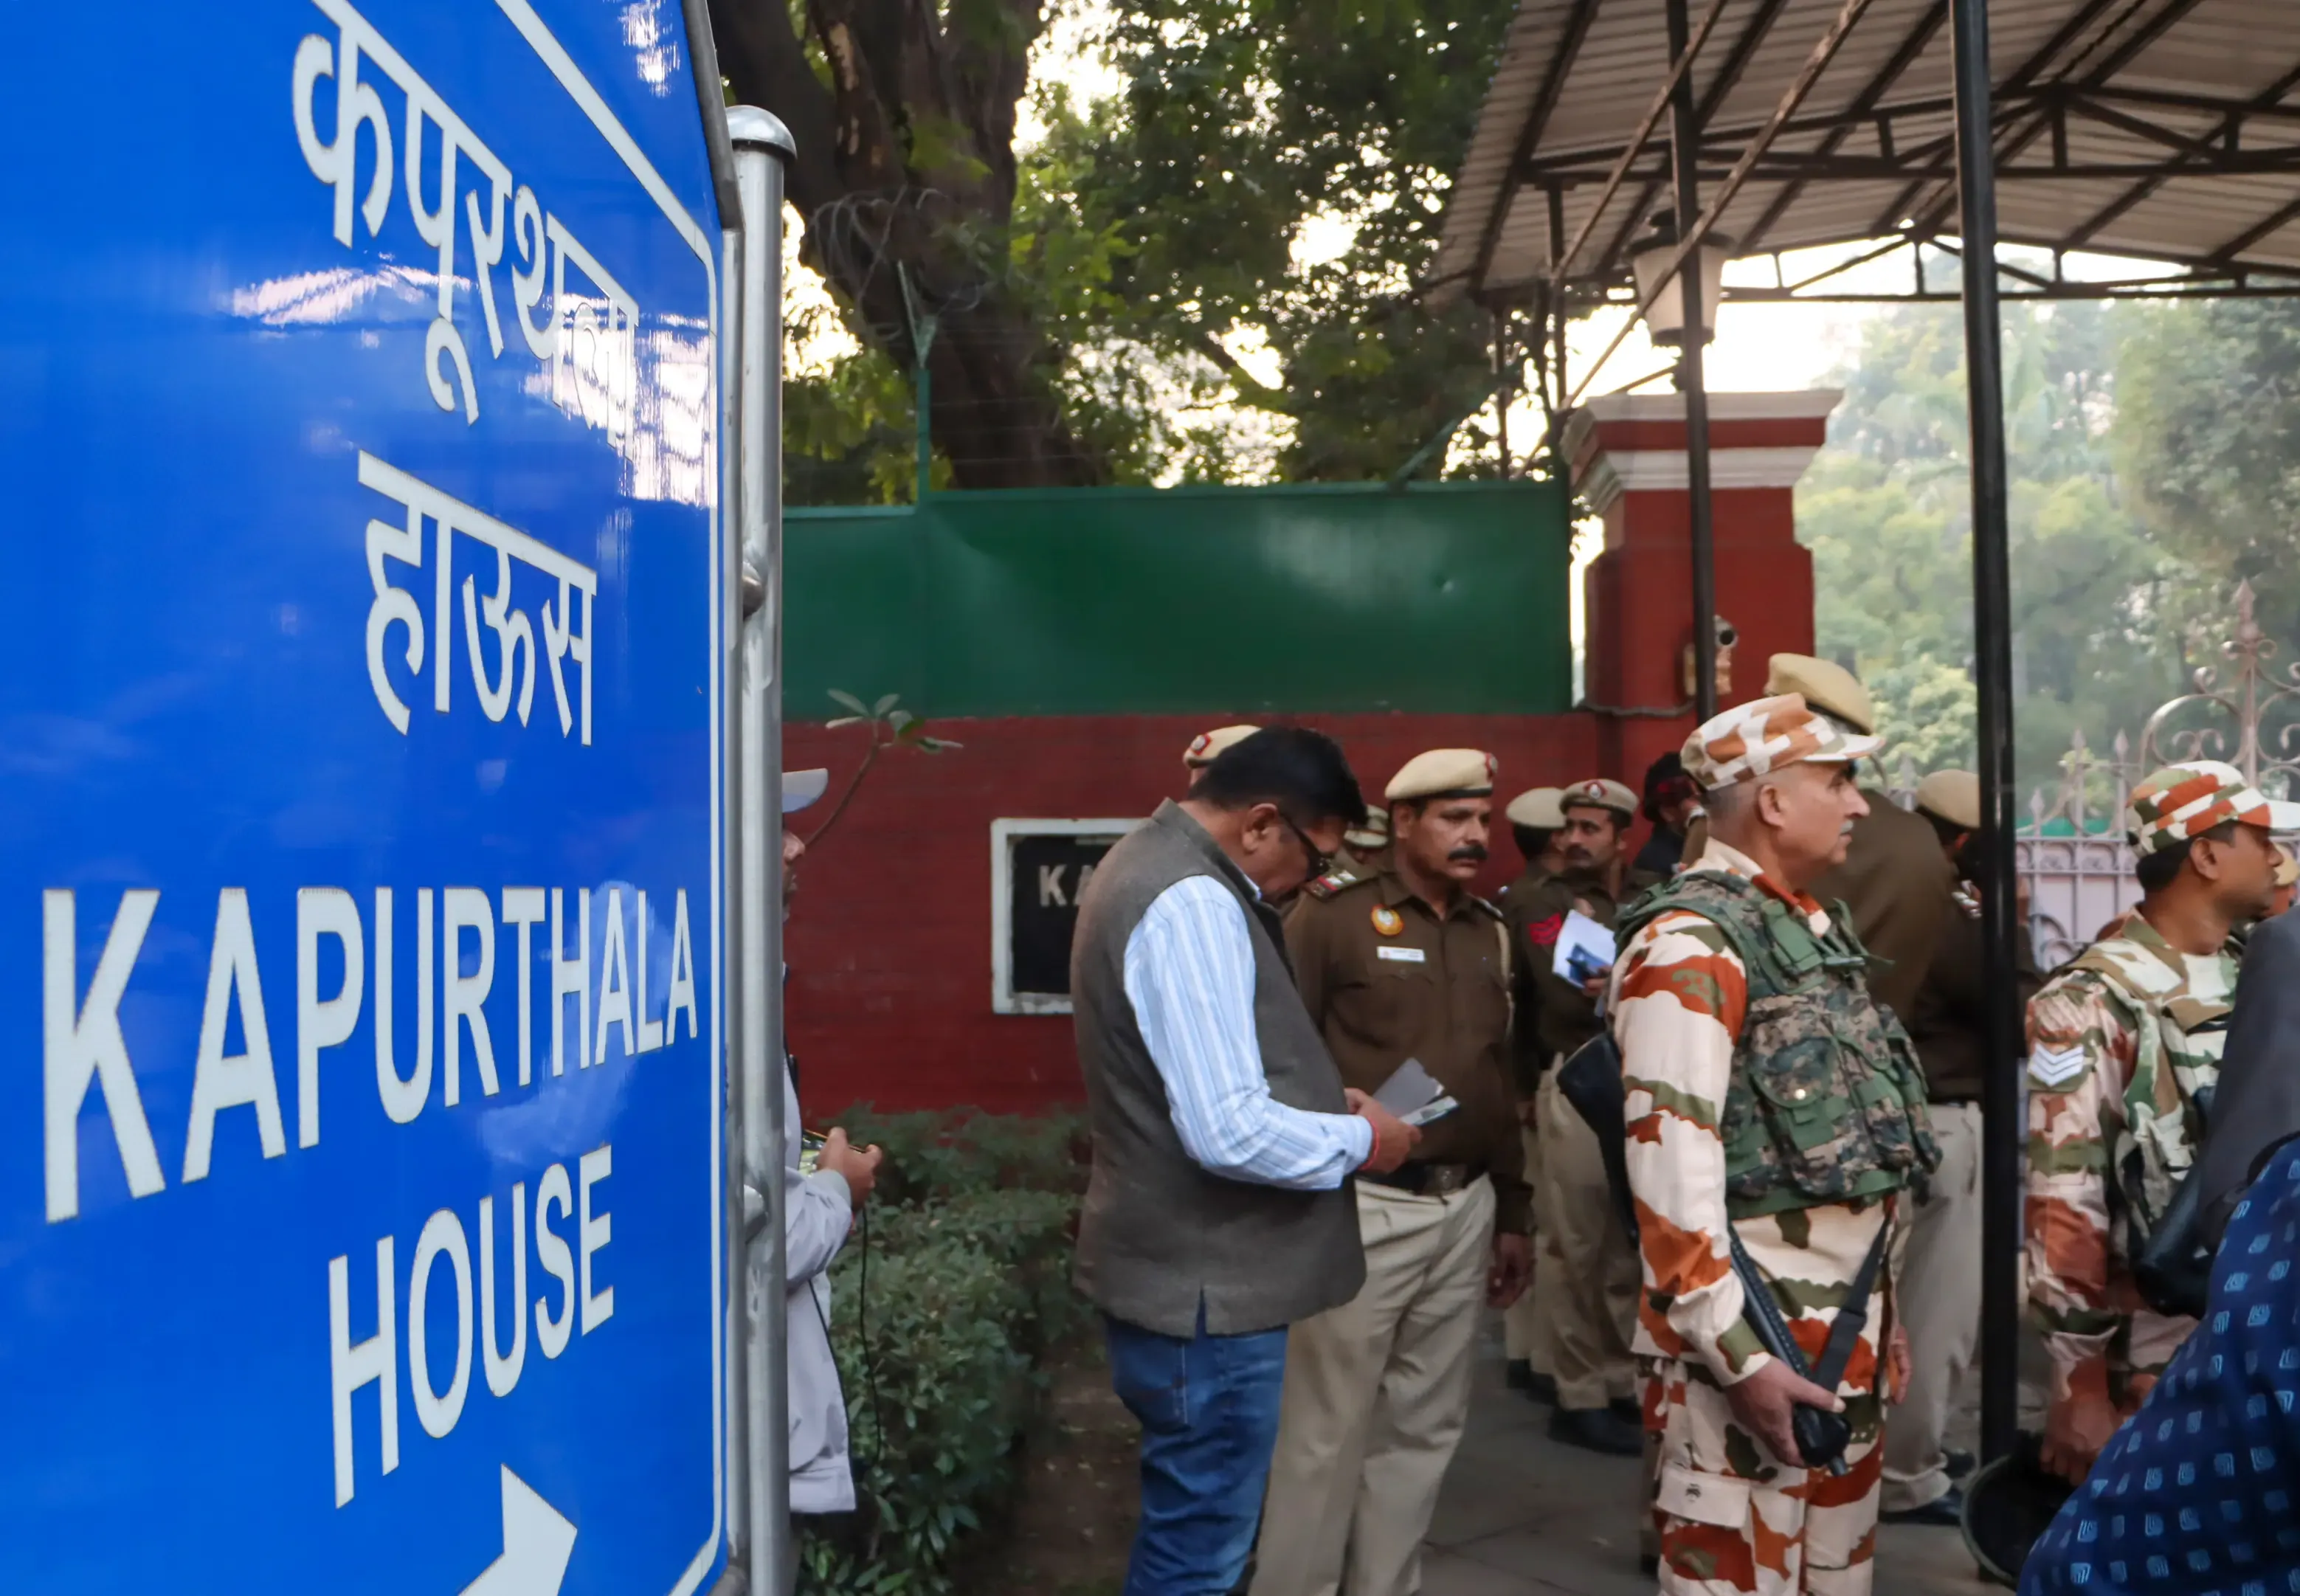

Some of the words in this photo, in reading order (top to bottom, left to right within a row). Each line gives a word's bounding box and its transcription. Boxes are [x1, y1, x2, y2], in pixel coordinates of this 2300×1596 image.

[291, 0, 639, 463] कपूरथला
[358, 449, 597, 746] हाऊस
[42, 887, 697, 1225] KAPURTHALA
[328, 1142, 614, 1510] HOUSE
